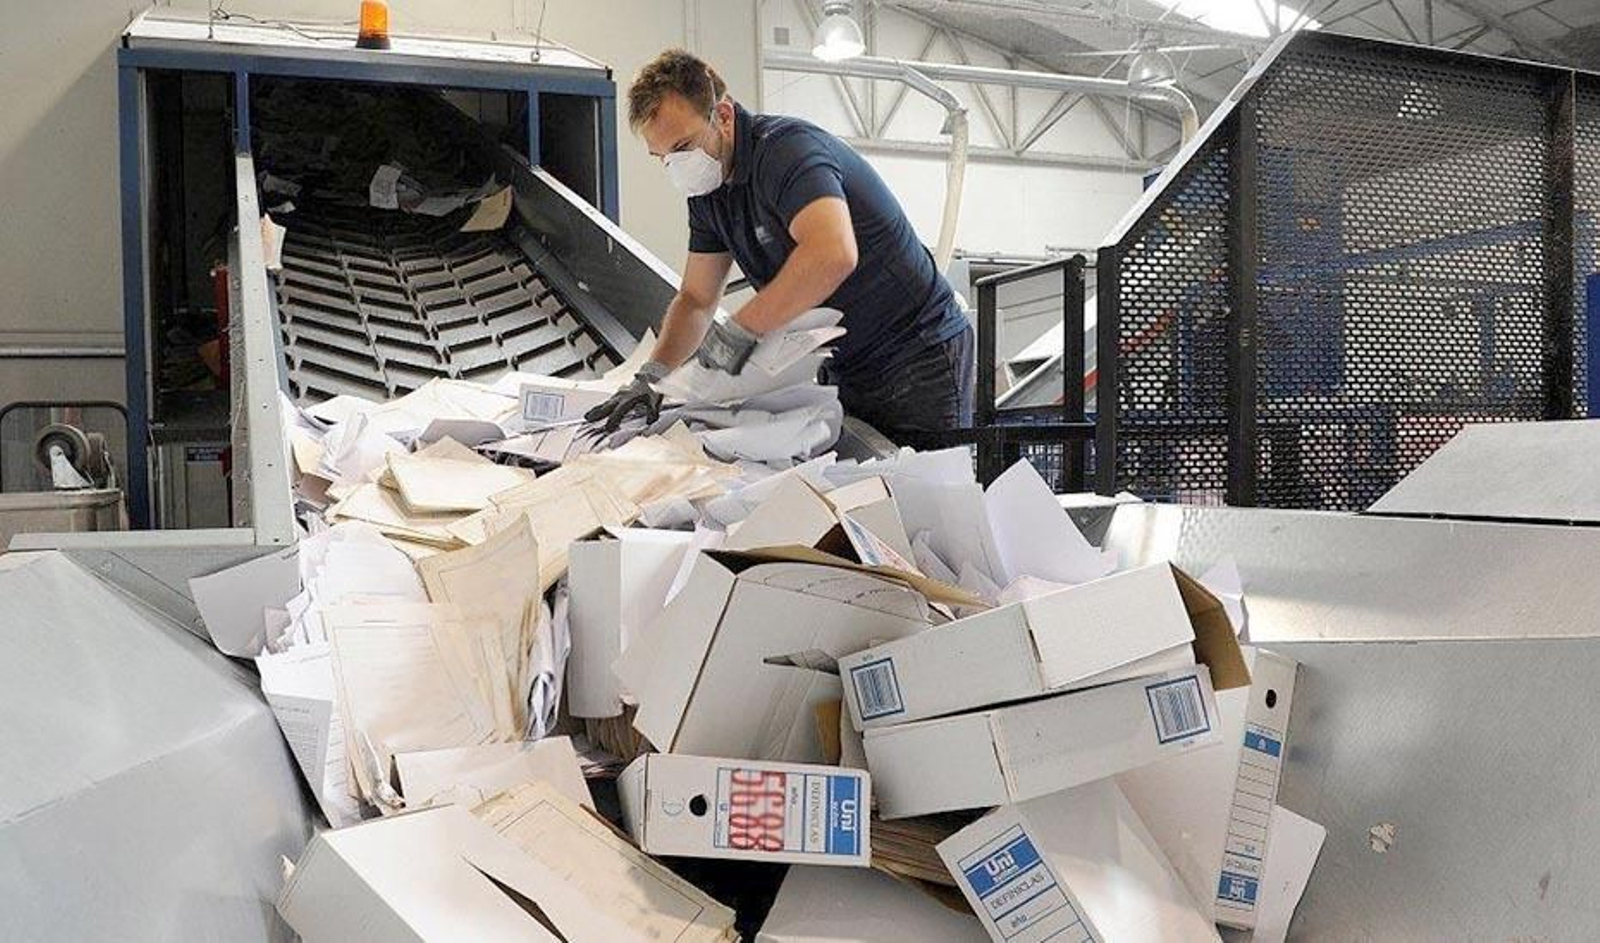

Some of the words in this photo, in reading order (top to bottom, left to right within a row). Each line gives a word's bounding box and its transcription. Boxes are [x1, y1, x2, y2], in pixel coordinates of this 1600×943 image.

[841, 799, 857, 831] Uni
[984, 850, 1015, 876] Uni
[990, 872, 1045, 910] DEFINICLAS
